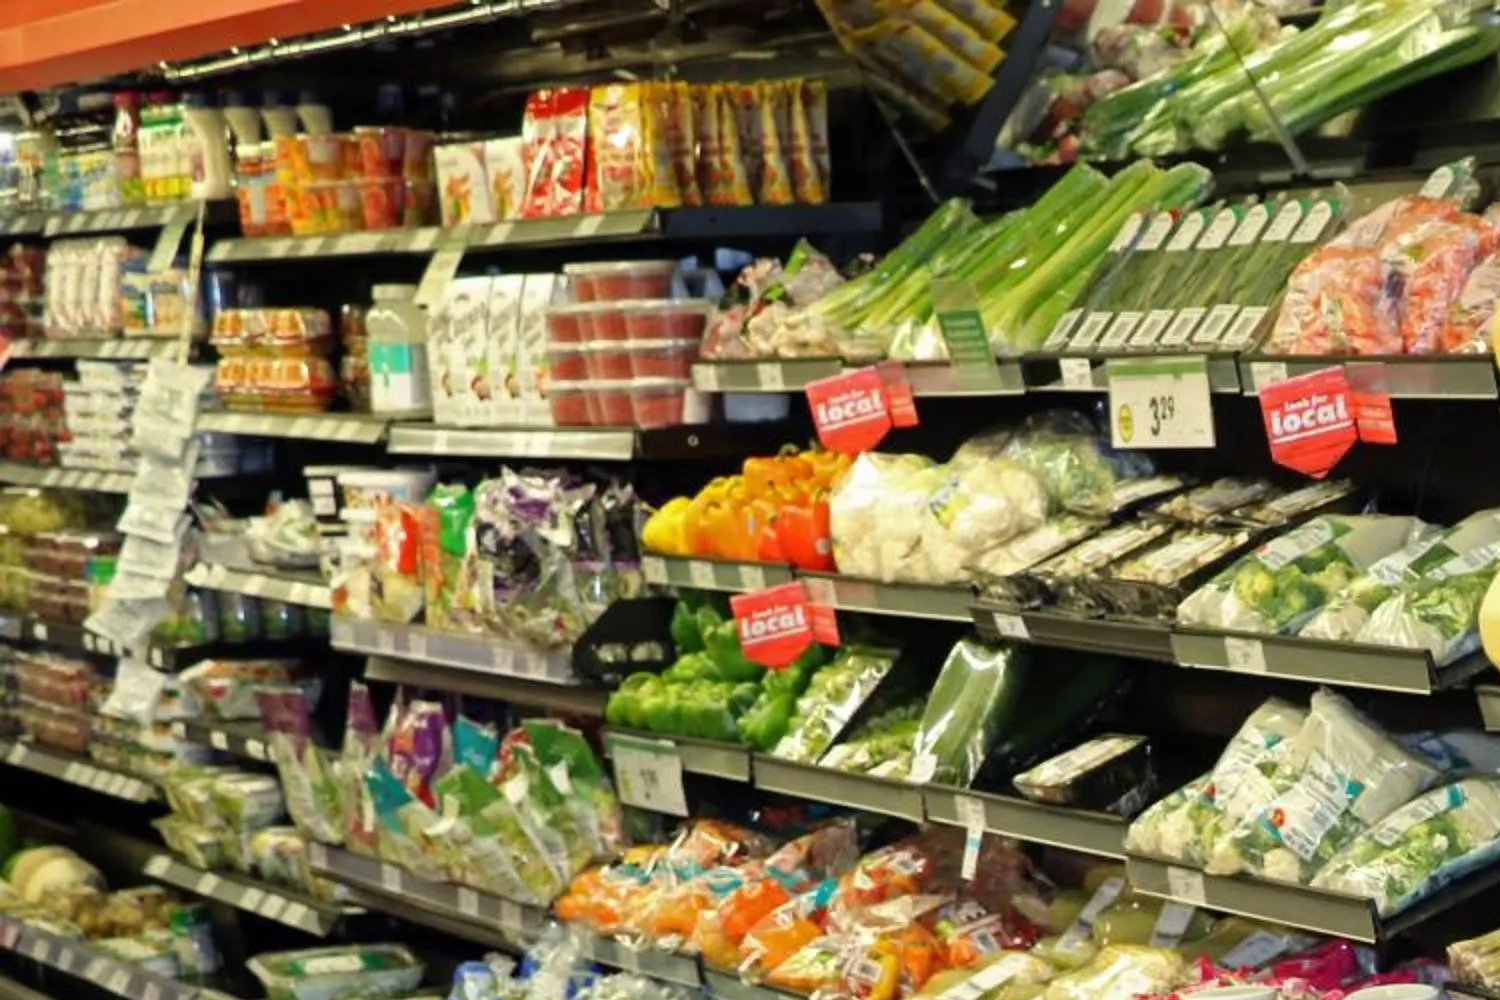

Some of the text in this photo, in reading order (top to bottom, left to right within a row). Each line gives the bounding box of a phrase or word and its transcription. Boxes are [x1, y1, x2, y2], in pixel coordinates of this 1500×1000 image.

[816, 388, 884, 425] local
[1271, 394, 1348, 437] local
[741, 604, 805, 638] local
